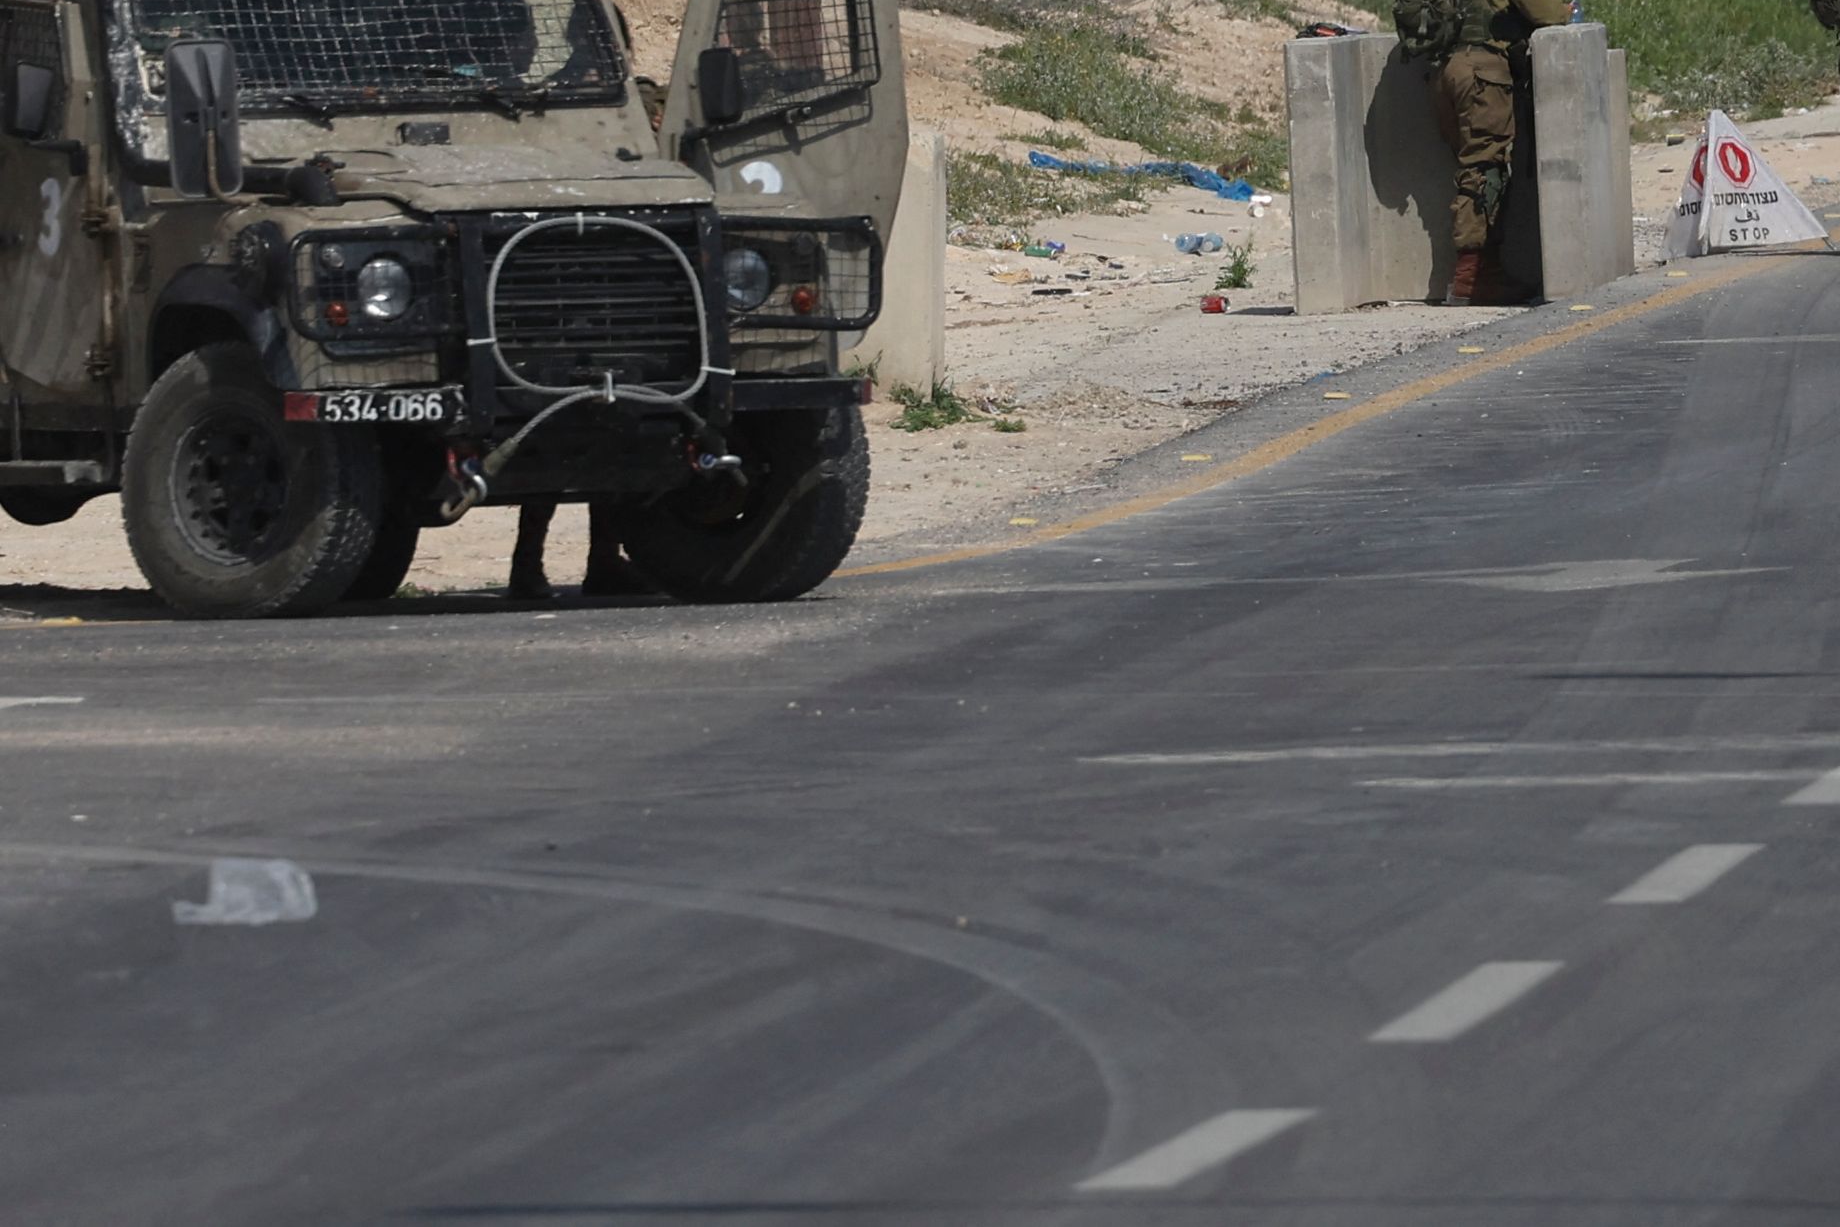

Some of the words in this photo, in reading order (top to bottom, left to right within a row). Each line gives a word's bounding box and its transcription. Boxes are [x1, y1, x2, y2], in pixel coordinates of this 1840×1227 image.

[1713, 192, 1749, 206] מחסום
[1749, 190, 1778, 205] עצור
[39, 178, 60, 255] 3
[1729, 227, 1770, 242] STOP
